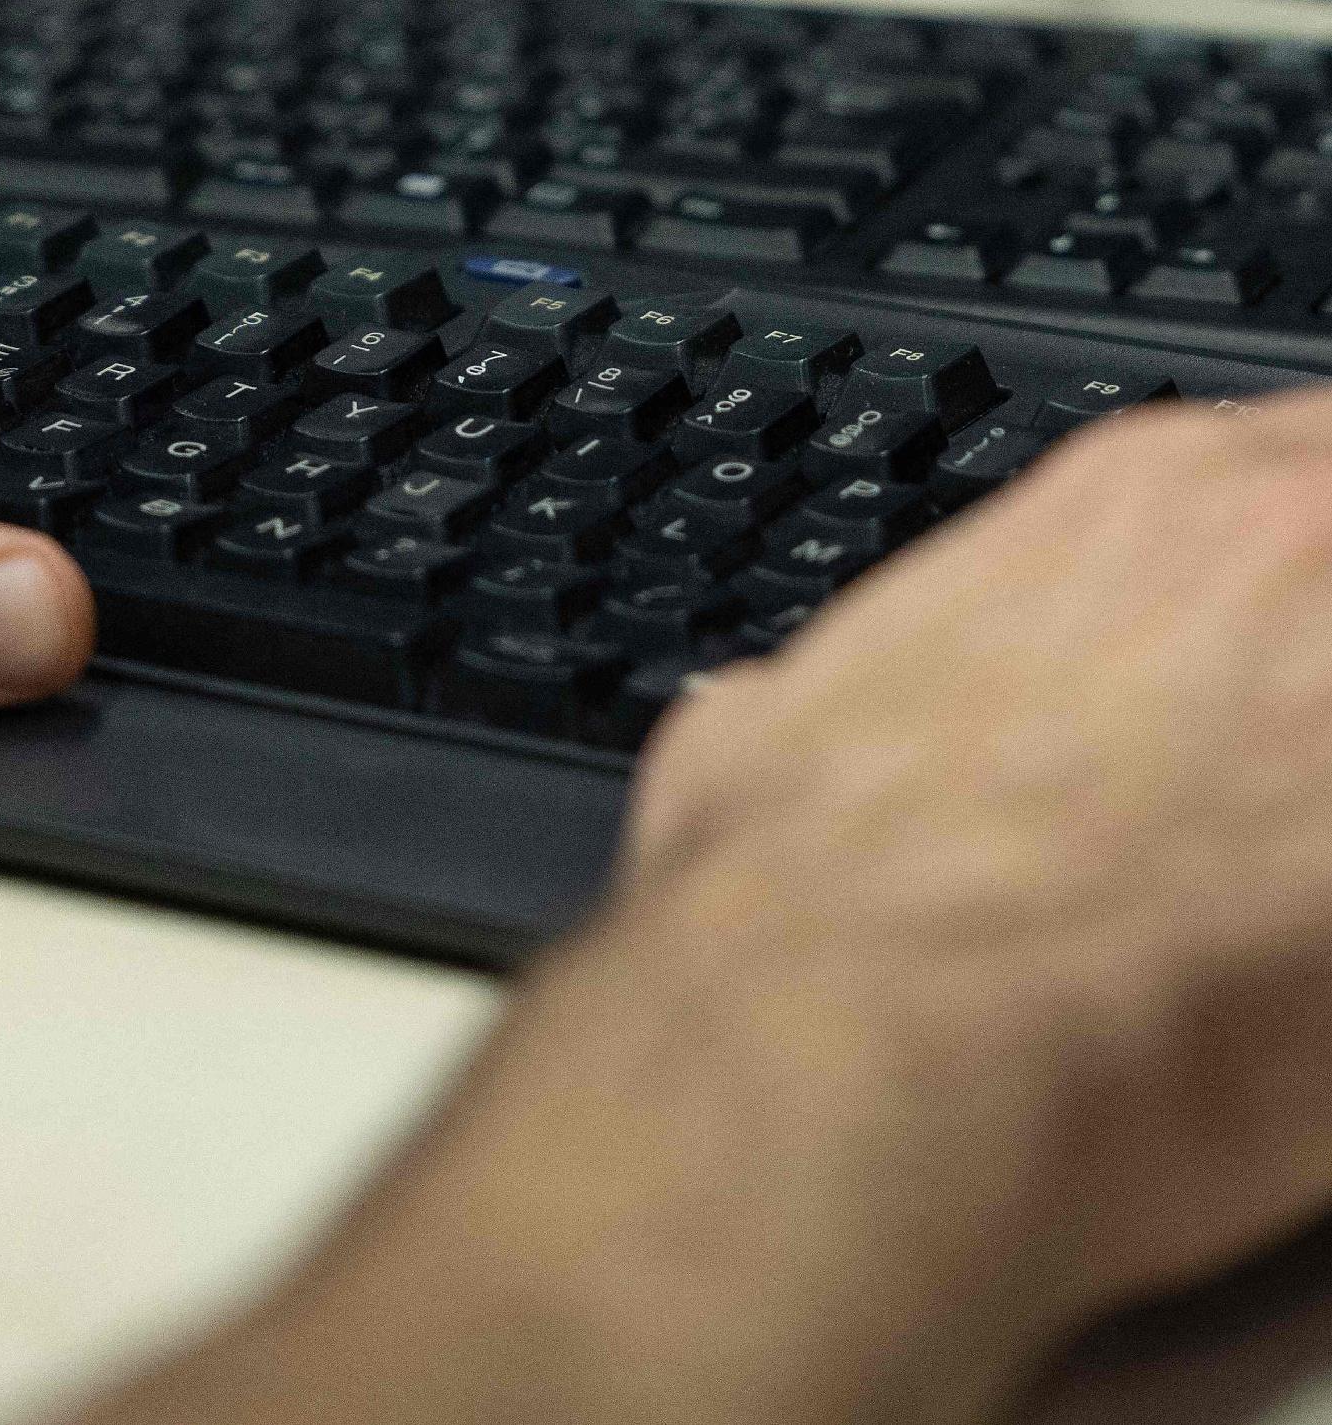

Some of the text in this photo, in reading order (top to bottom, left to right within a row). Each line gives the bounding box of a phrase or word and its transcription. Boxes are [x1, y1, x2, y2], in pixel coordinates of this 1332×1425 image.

[13, 274, 38, 289] 3
[348, 266, 385, 282] F4
[124, 294, 150, 308] 4
[529, 296, 568, 311] F5
[242, 311, 269, 326] 5
[639, 310, 676, 326] F6
[360, 331, 386, 346] 6
[764, 330, 804, 344] F7
[481, 350, 509, 365] 7
[889, 347, 926, 362] F8
[96, 361, 137, 382] R
[597, 367, 623, 382] 8
[225, 381, 259, 399] T
[728, 388, 753, 403] 9
[1082, 380, 1122, 395] F9
[344, 401, 379, 419] Y
[857, 410, 883, 425] 0
[40, 418, 83, 434] F
[454, 417, 496, 439] U
[166, 440, 208, 459] G
[576, 438, 601, 457] I
[284, 458, 332, 479] H
[711, 460, 755, 483] O
[27, 476, 67, 491] V
[402, 478, 441, 497] J
[838, 478, 883, 501] P
[527, 496, 572, 520] K
[254, 516, 303, 541] N
